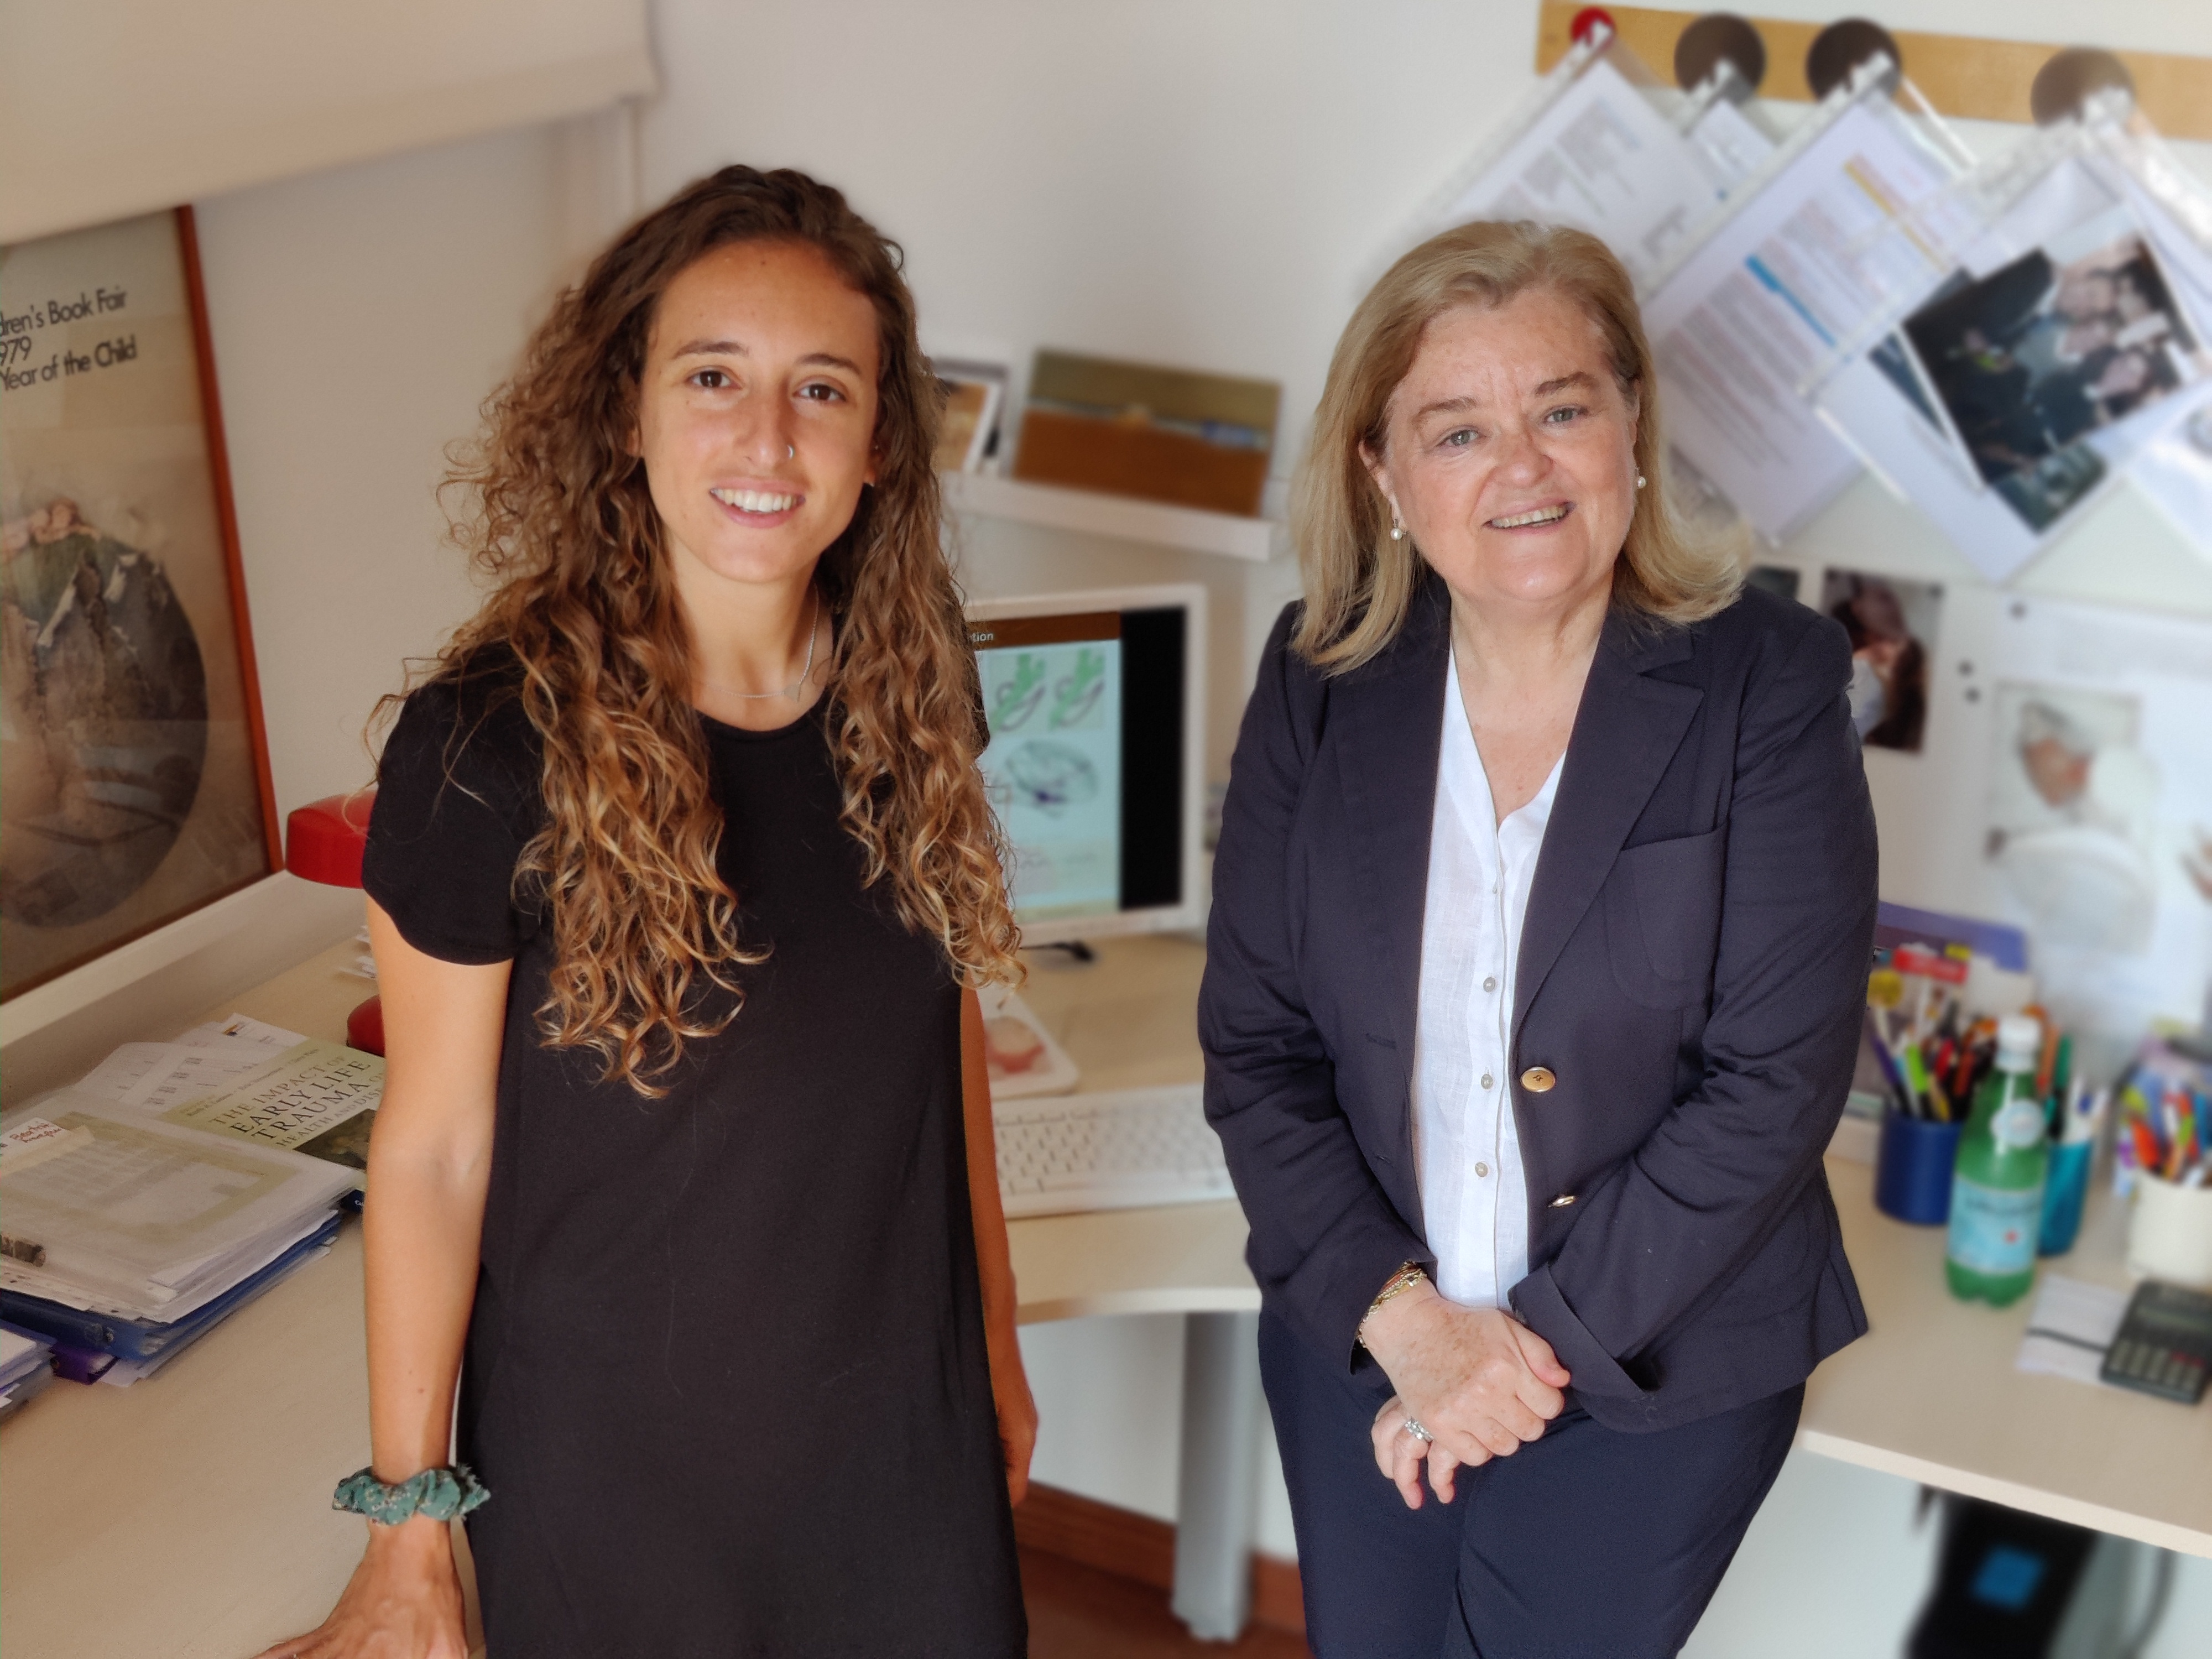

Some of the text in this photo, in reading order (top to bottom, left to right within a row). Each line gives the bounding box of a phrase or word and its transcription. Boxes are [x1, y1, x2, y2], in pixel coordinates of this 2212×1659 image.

[48, 292, 93, 325] Book
[96, 285, 127, 313] Fair
[0, 333, 137, 391] Year of the Child
[208, 1103, 255, 1124] THE
[252, 1065, 325, 1103] IMPACT
[326, 1056, 345, 1067] OF
[230, 1089, 312, 1133] EARLY
[309, 1061, 371, 1091] LIFE
[251, 1083, 371, 1139] TRAUMA
[276, 1115, 333, 1147] HEALTH
[334, 1104, 357, 1118] AND
